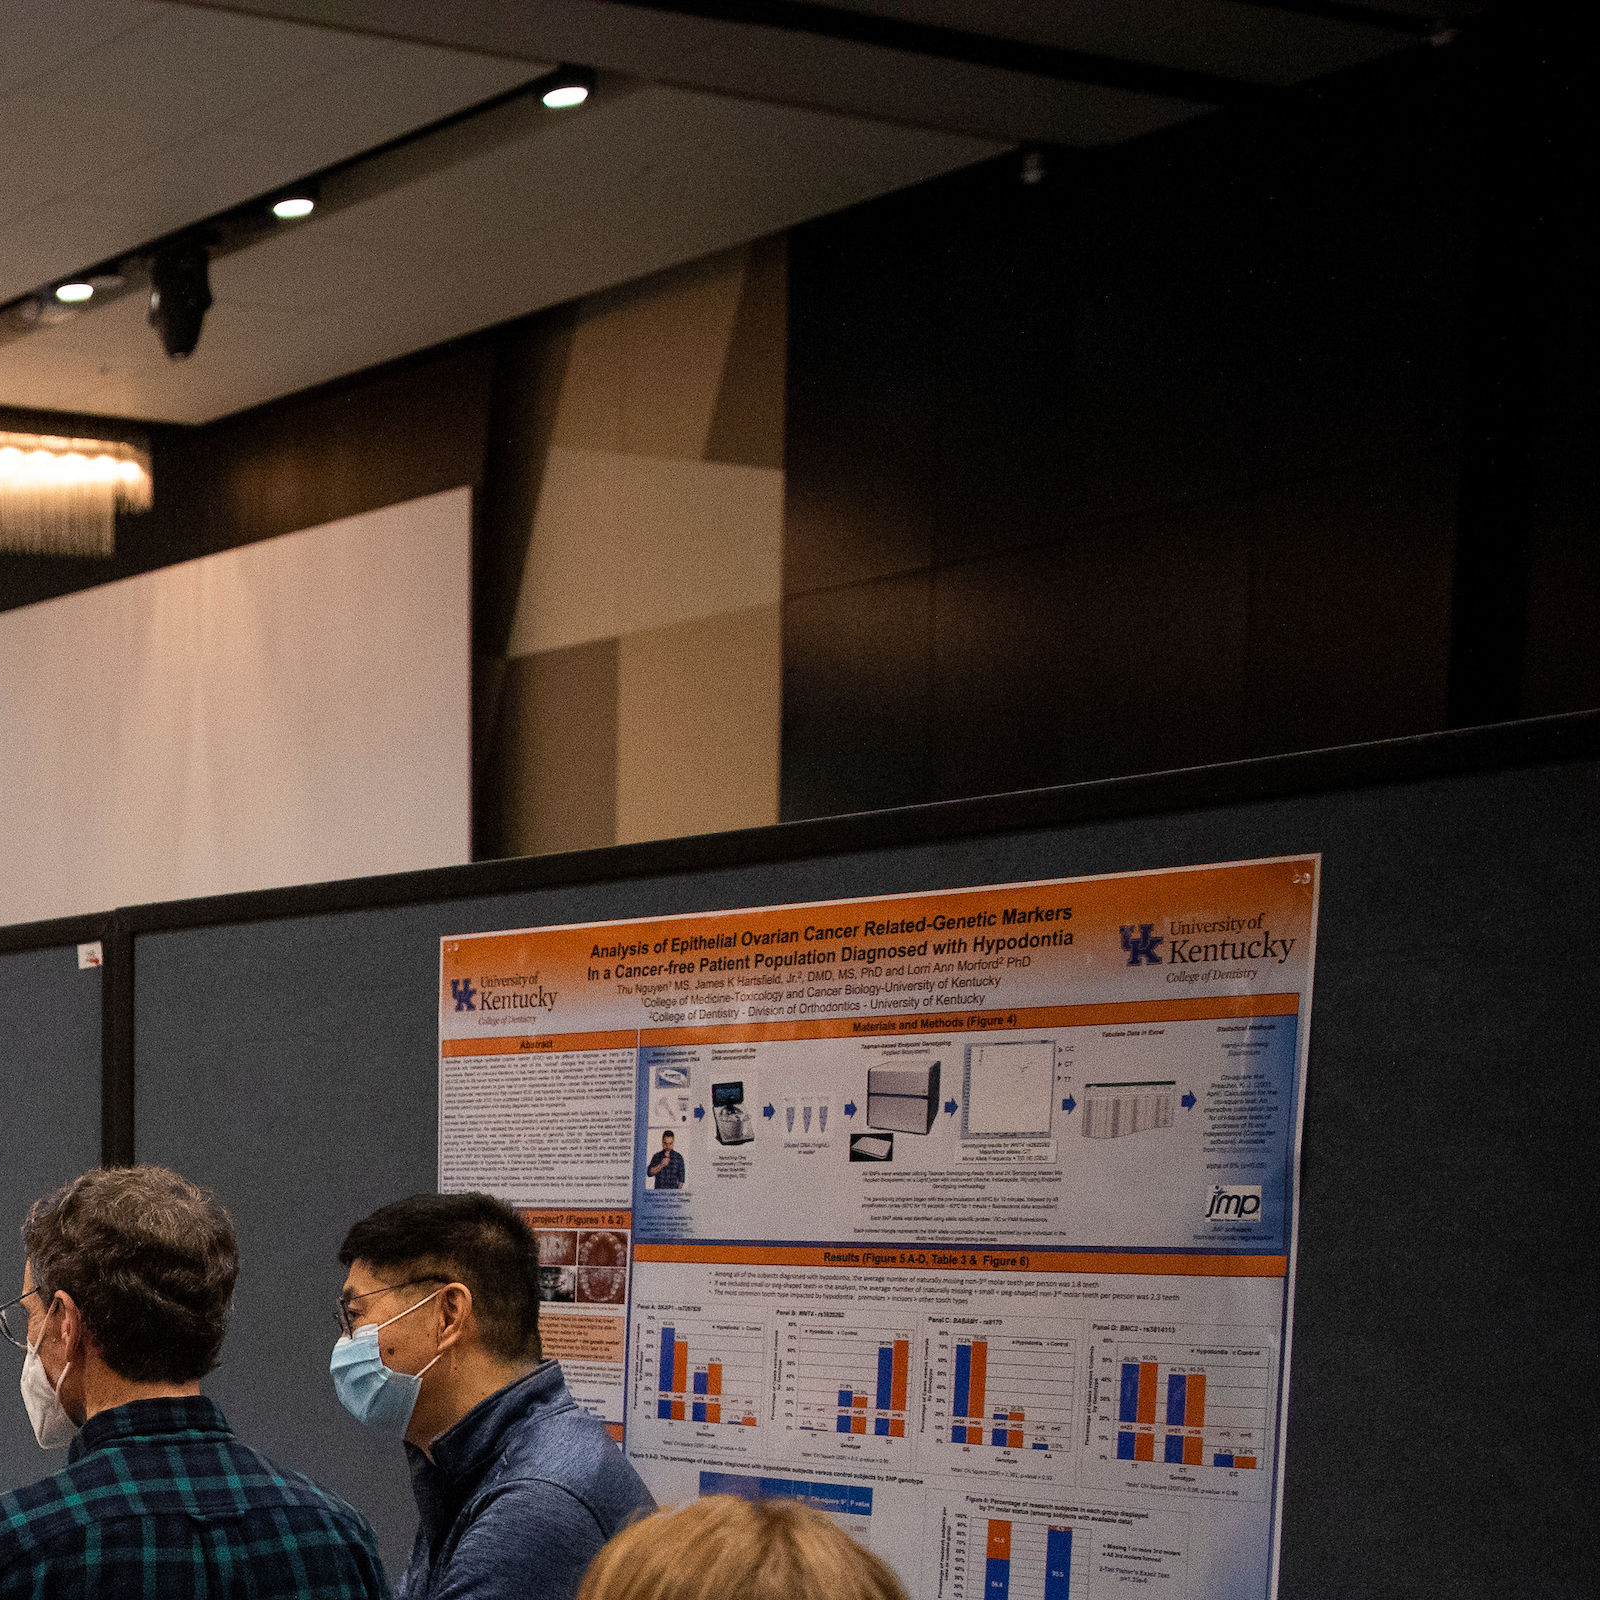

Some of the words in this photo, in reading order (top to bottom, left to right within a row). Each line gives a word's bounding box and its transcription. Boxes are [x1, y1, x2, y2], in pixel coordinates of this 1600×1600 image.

[590, 940, 648, 959] Analysis
[653, 938, 667, 953] of
[671, 933, 736, 954] Epithelial
[741, 929, 798, 946] Ovarian
[804, 926, 859, 941] Cancer
[864, 912, 996, 936] Related-Genetic
[1002, 904, 1072, 925] Markers
[1170, 916, 1246, 935] University
[1247, 913, 1265, 929] of
[587, 966, 598, 981] In
[603, 969, 610, 980] a
[615, 960, 694, 979] Cancer-free
[700, 954, 749, 972] Patient
[754, 949, 835, 971] Population
[841, 941, 927, 963] Diagnosed
[933, 938, 966, 955] with
[973, 930, 1073, 954] Hypodontia
[1120, 923, 1163, 967] UK
[1167, 930, 1297, 965] Kentucky
[481, 974, 529, 988] University
[529, 971, 539, 985] of
[617, 984, 632, 994] Thu
[694, 979, 724, 989] James
[727, 977, 734, 987] K
[807, 970, 834, 981] DMD,
[838, 969, 857, 979] MS,
[860, 966, 882, 978] PhD
[885, 965, 903, 976] and
[907, 963, 930, 974] Lorri
[933, 963, 953, 973] Ann
[1007, 956, 1031, 968] PhD
[1166, 970, 1200, 984] College
[1202, 969, 1213, 983] of
[1212, 968, 1258, 981] Dentistry
[451, 978, 477, 1012] UK
[479, 985, 558, 1012] Kentucky
[679, 995, 688, 1005] of
[691, 990, 783, 1004] Medicine-Toxicology
[786, 987, 803, 998] and
[806, 987, 842, 996] Cancer
[844, 979, 935, 995] Biology-University
[938, 978, 948, 988] of
[951, 975, 1001, 987] Kentucky
[687, 1010, 697, 1020] of
[699, 1008, 739, 1019] Dentistry
[748, 1005, 784, 1016] Division
[786, 1003, 797, 1013] of
[799, 1000, 860, 1013] Orthodontics
[870, 996, 918, 1008] University
[923, 995, 933, 1005] of
[935, 992, 985, 1004] Kentucky
[853, 1021, 895, 1032] Materials
[899, 1019, 917, 1029] and
[920, 1017, 963, 1028] Methods
[967, 1014, 1003, 1028] (Figure
[1006, 1013, 1017, 1025] 4)
[520, 1040, 552, 1050] Abstract
[1205, 1185, 1260, 1218] jmp
[532, 1214, 564, 1225] project?
[566, 1214, 598, 1225] (Figures
[617, 1216, 624, 1225] 2)
[824, 1253, 859, 1263] Results
[862, 1253, 898, 1264] (Figure
[900, 1254, 905, 1263] 5
[907, 1254, 929, 1265] A-D,
[932, 1255, 957, 1264] Table
[961, 1255, 965, 1265] 3
[969, 1256, 976, 1265] &
[983, 1256, 1016, 1267] Figure
[1019, 1256, 1029, 1267] 6)
